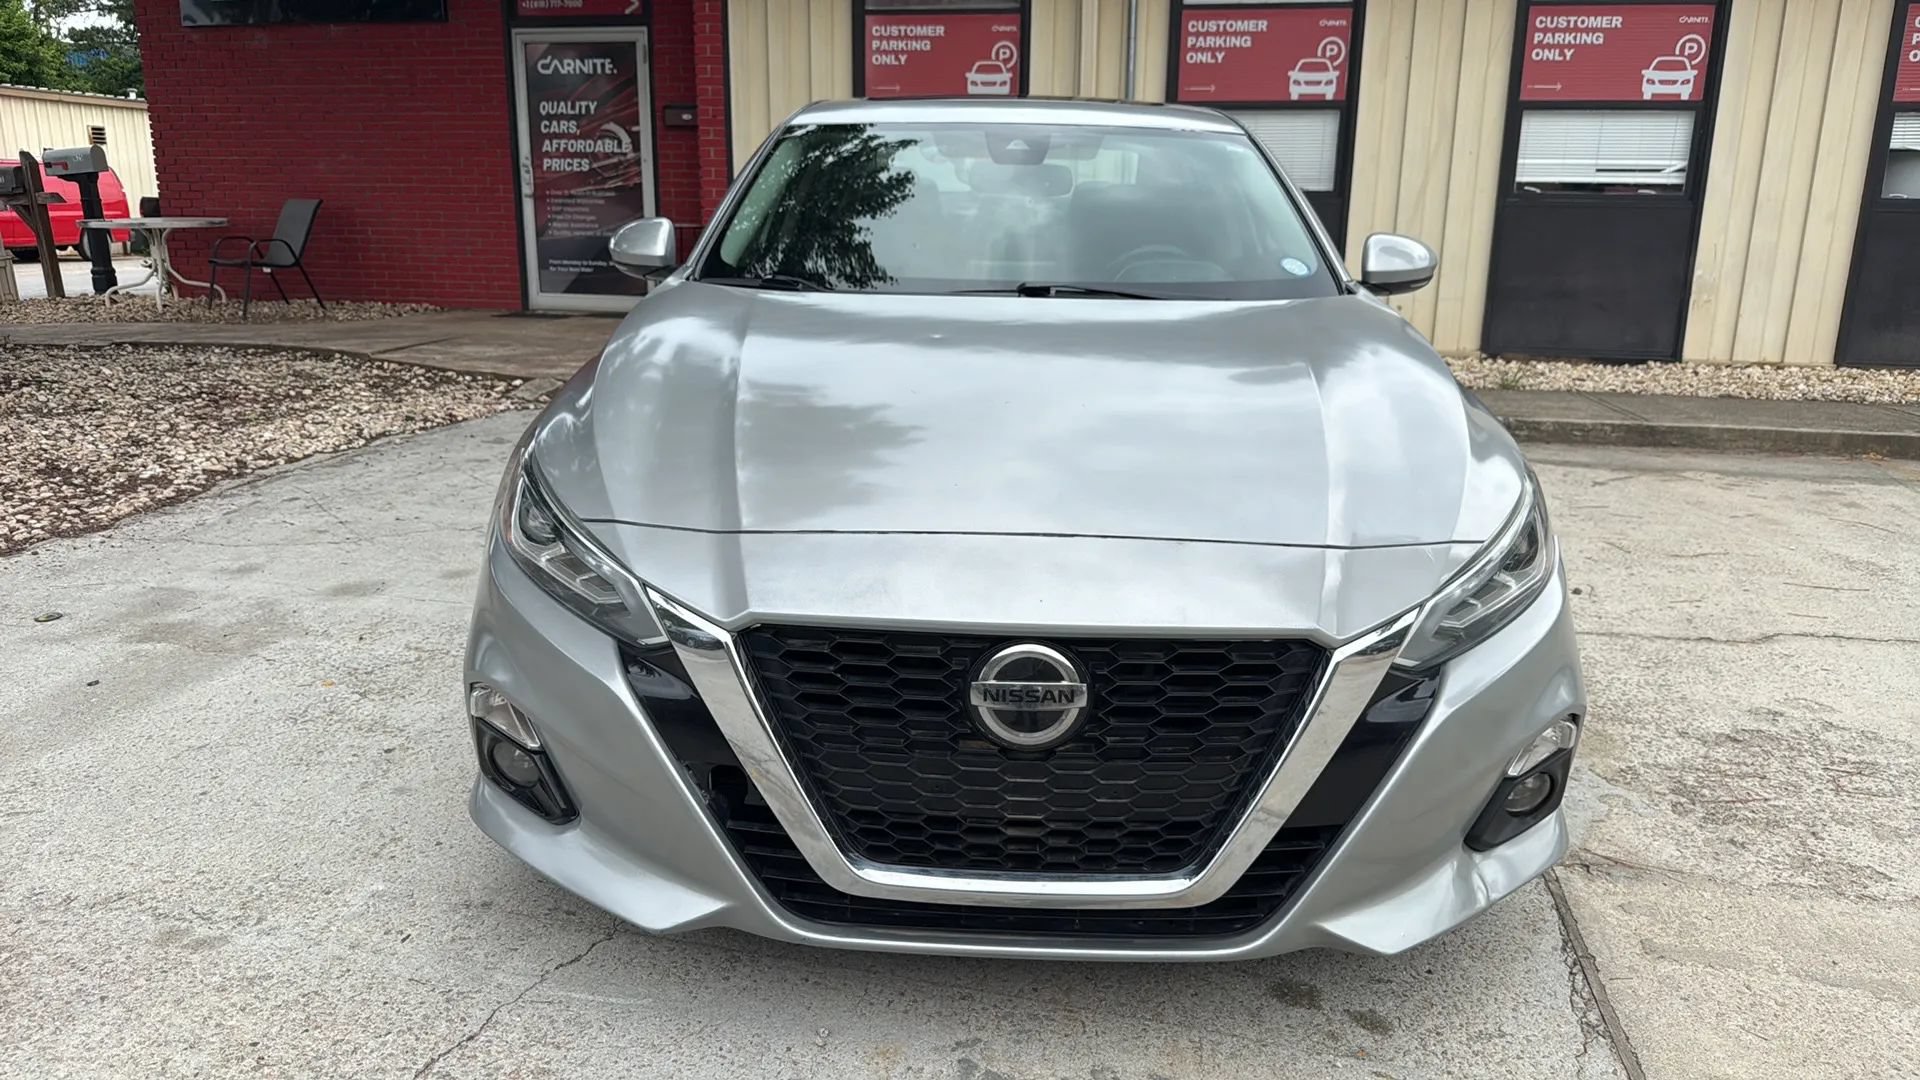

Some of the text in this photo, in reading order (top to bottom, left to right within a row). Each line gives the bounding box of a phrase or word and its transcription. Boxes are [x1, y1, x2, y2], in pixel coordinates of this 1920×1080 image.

[1188, 20, 1268, 32] CUSTOMER
[1535, 16, 1623, 28] CUSTOMER
[872, 25, 945, 37] CUSTOMER
[1187, 36, 1252, 48] PARKING
[1533, 32, 1605, 45] PARKING
[872, 40, 931, 51] PARKING
[872, 54, 908, 65] ONLY
[1186, 52, 1225, 64] ONLY
[1531, 48, 1575, 61] ONLY
[540, 101, 597, 116] QUALITY
[540, 120, 580, 136] CARS,
[542, 139, 633, 153] AFFORDABLE
[543, 158, 591, 172] PRICES
[983, 688, 1075, 704] NISSAN
